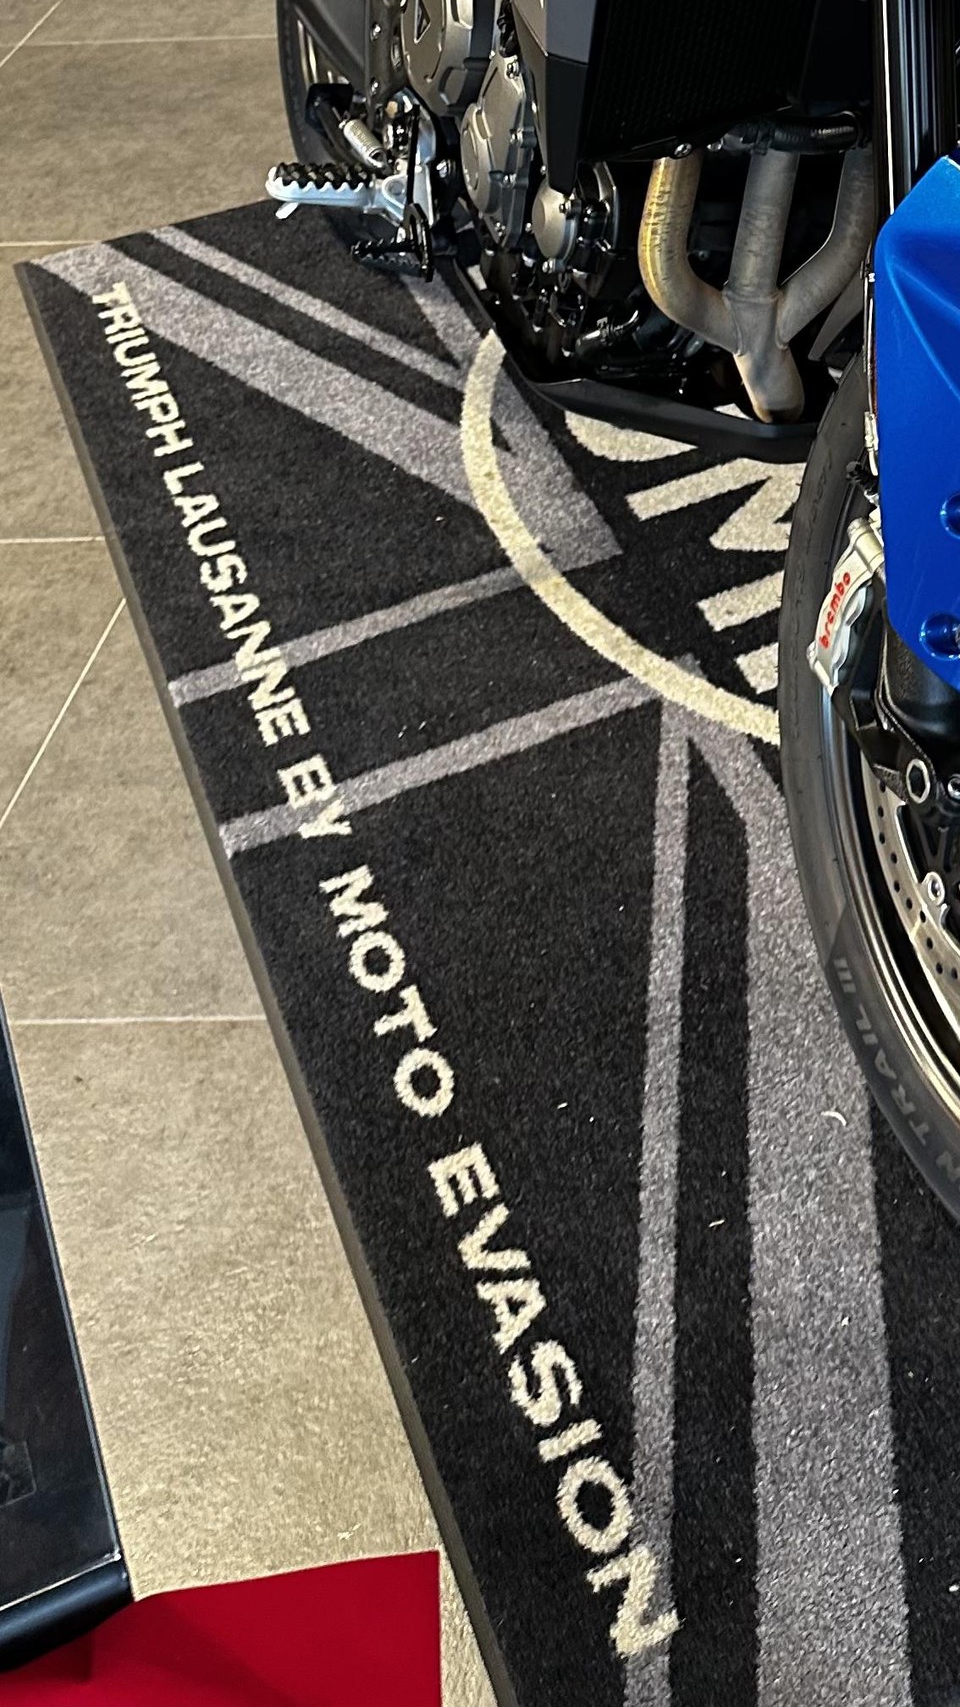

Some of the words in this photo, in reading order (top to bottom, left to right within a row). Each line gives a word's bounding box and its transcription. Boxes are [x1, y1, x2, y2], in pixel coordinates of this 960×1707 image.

[92, 281, 195, 457] TRIUMPH
[163, 461, 311, 747] LAUSANNE
[277, 753, 353, 839] BY
[318, 864, 455, 1119] MOTO
[427, 1143, 683, 1658] EVASION
[819, 572, 851, 650] brembo
